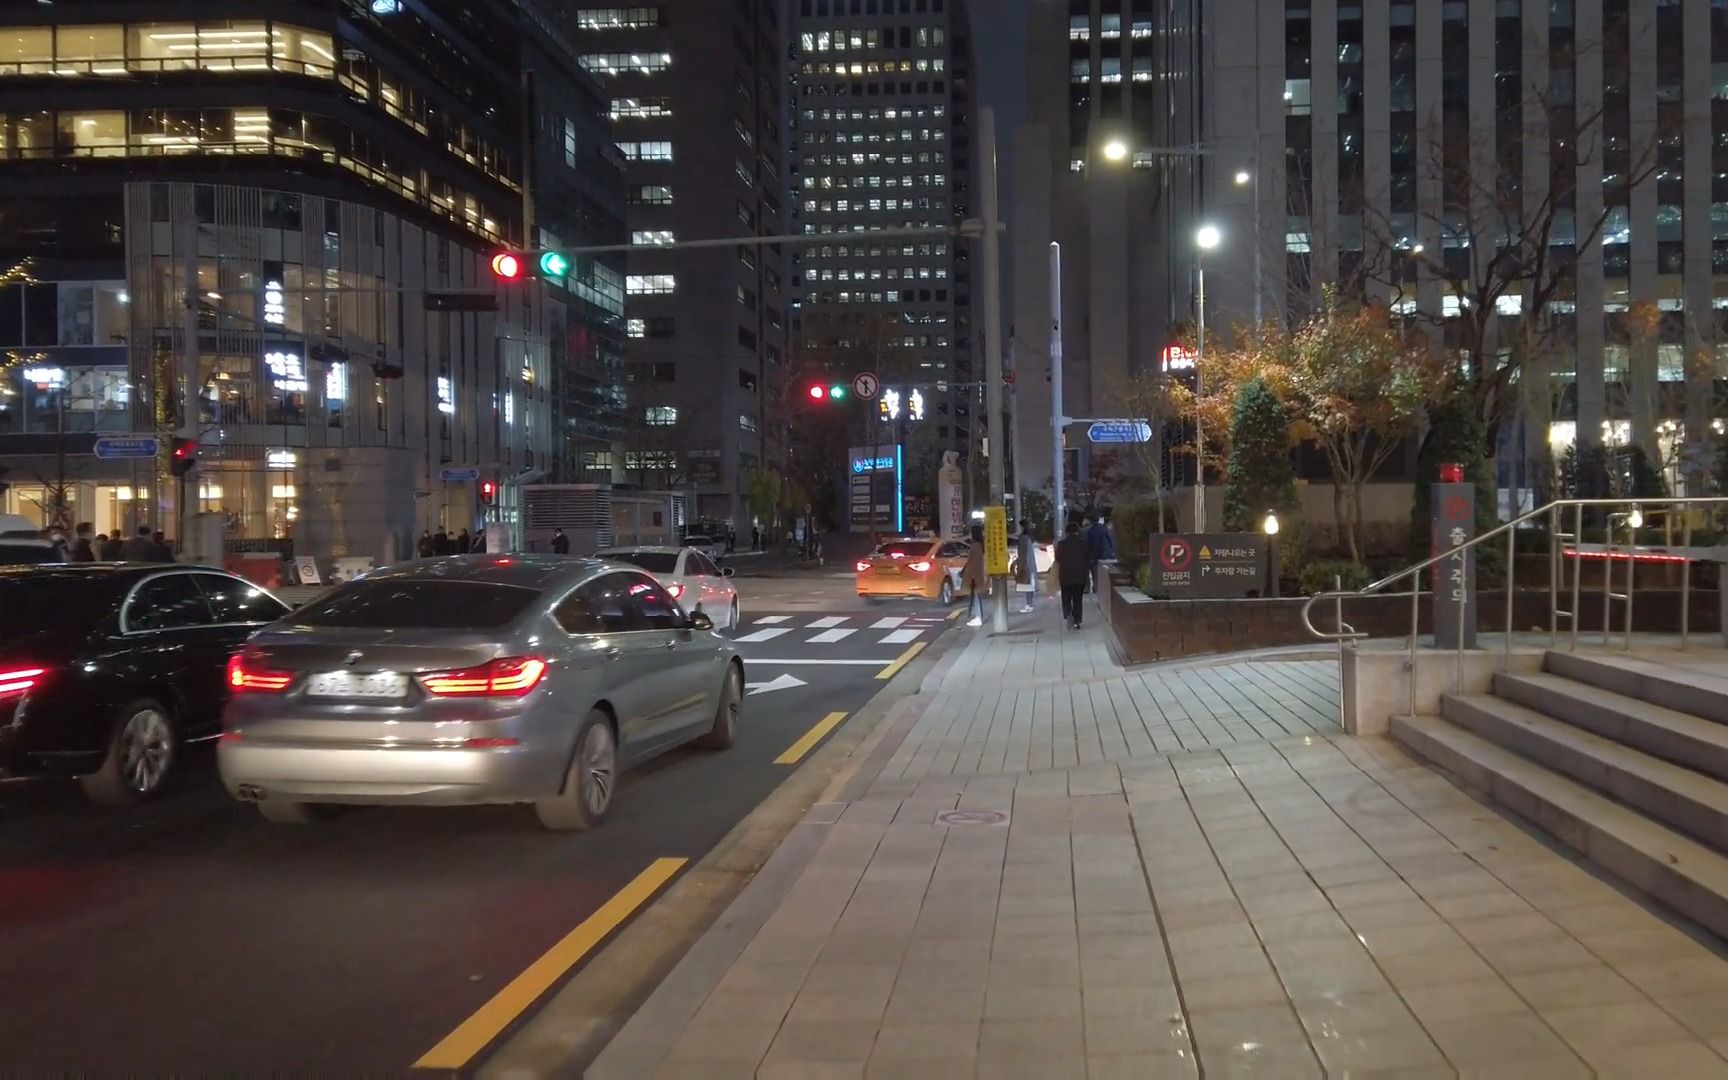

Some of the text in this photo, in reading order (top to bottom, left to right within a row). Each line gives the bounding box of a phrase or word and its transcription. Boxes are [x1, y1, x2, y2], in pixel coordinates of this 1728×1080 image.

[1162, 570, 1190, 581] 진입금지
[1214, 567, 1256, 576] 주차장 가는길
